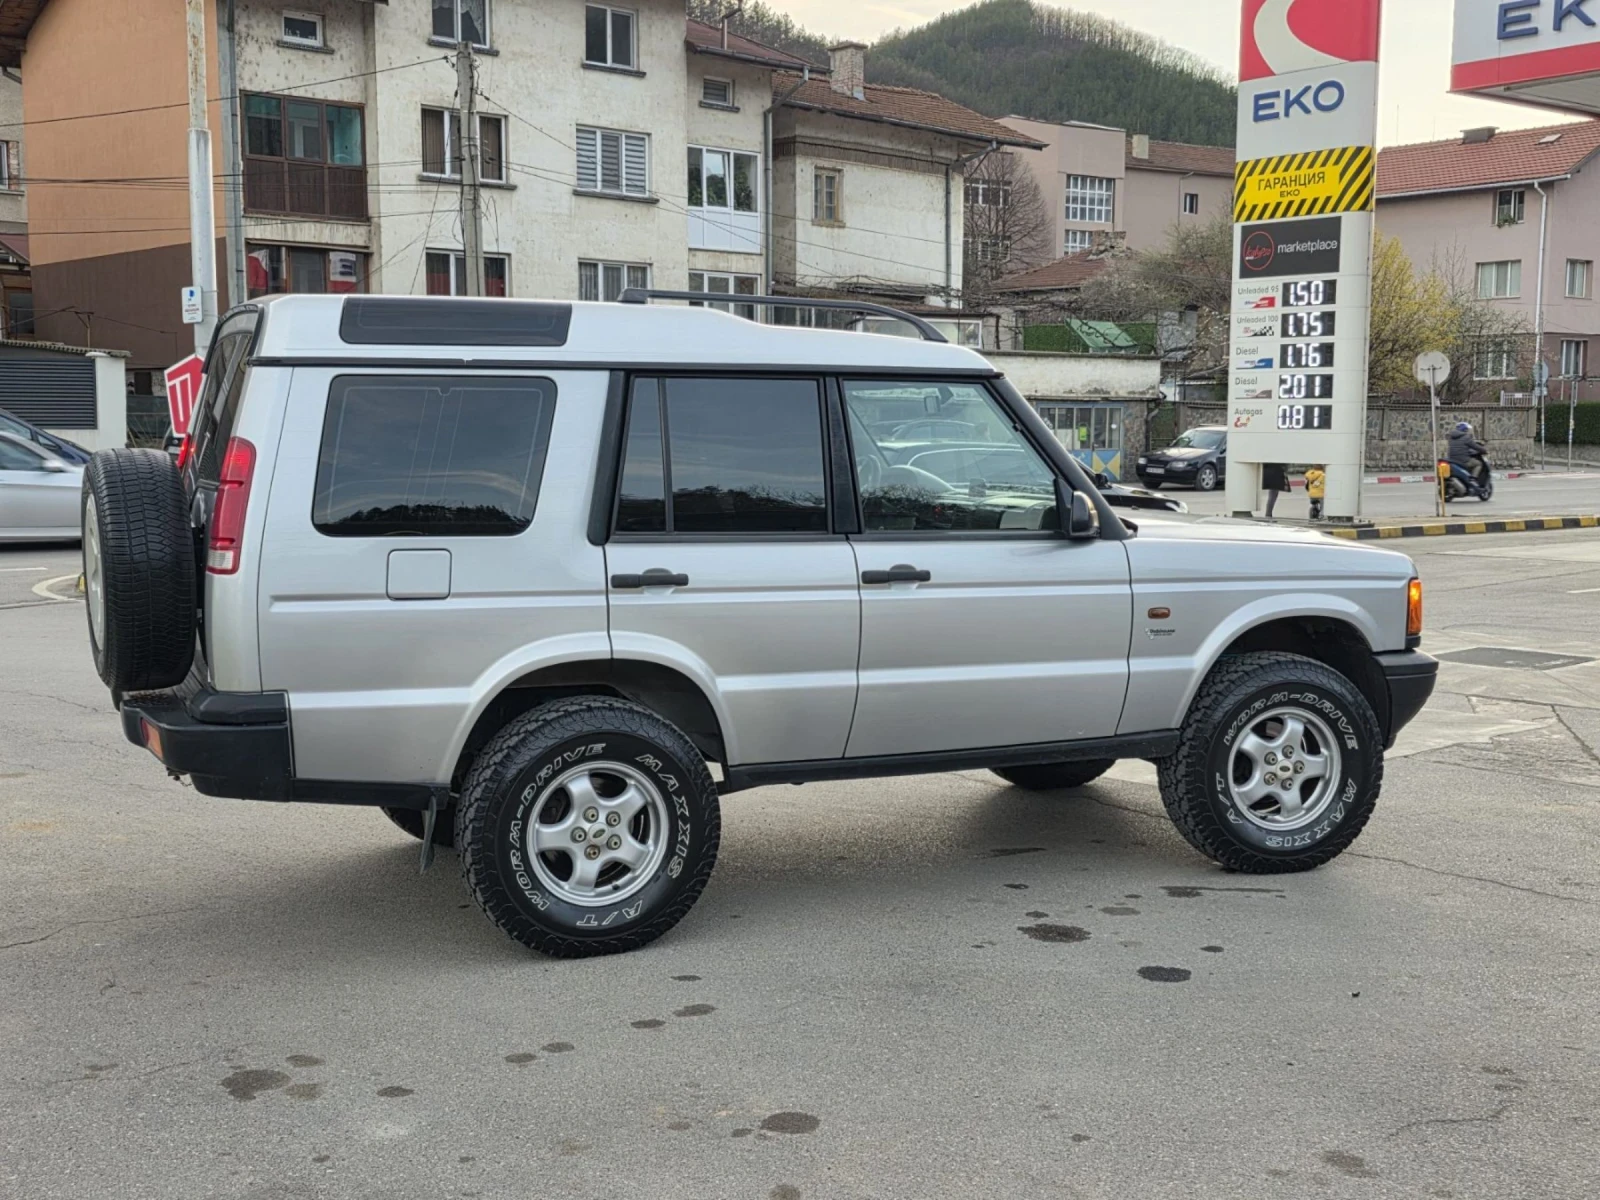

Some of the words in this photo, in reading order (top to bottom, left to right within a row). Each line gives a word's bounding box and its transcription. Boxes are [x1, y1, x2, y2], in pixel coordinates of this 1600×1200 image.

[1253, 80, 1345, 122] EKO
[1258, 172, 1325, 191] ГАРАНЦИЯ
[1280, 189, 1300, 198] EKO
[1278, 239, 1338, 253] marketplace
[1238, 286, 1269, 295] Unleaded
[1270, 285, 1279, 293] 95
[1290, 280, 1323, 306] 1.50
[1237, 316, 1267, 324] Unleaded
[1268, 315, 1279, 323] 100
[1288, 311, 1322, 336] 1.75
[1236, 347, 1258, 355] Diesel
[1287, 343, 1321, 367] 1.76
[1235, 377, 1258, 385] Diesel
[1279, 375, 1321, 398] 2.01
[1234, 408, 1263, 416] Autogas
[1278, 405, 1319, 428] 0.81
[1224, 691, 1359, 750] WORM-DRIVE
[1216, 772, 1243, 825] A/T
[635, 753, 691, 879] MAXXIS
[1266, 779, 1358, 847] MAXXIS
[510, 742, 607, 912] WORM-DRIVE
[576, 899, 643, 927] A/T
